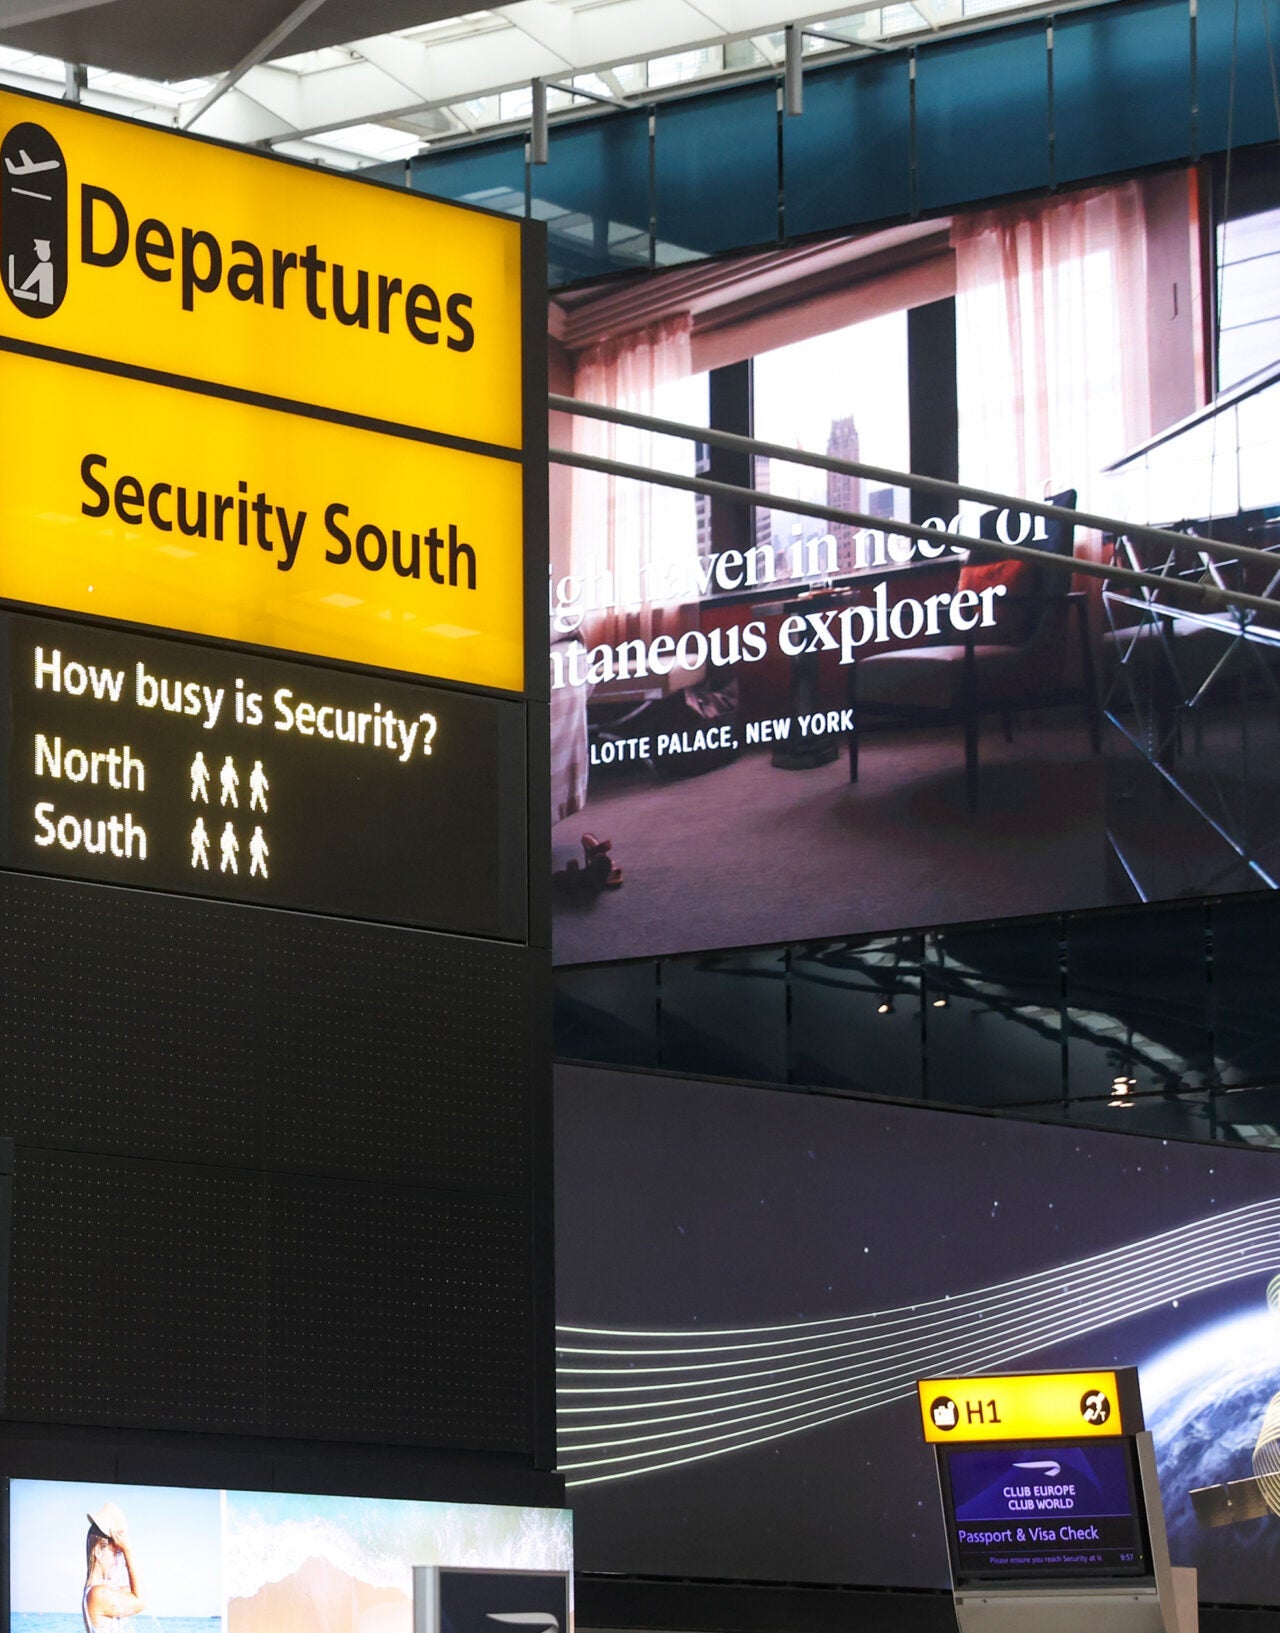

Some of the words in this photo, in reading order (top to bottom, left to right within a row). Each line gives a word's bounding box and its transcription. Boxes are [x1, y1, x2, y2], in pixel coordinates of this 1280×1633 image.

[79, 182, 476, 354] Departures
[79, 453, 308, 572] Security
[324, 502, 478, 591] South
[789, 522, 840, 578] in
[778, 581, 1007, 666] explorer
[33, 645, 125, 703] How
[135, 660, 225, 730] busy
[234, 677, 263, 726] is
[273, 687, 438, 763] Security?
[33, 733, 146, 792] North
[590, 736, 650, 765] LOTTE
[656, 725, 739, 756] PALACE,
[745, 717, 792, 745] NEW
[797, 708, 855, 737] YORK
[33, 801, 147, 861] South
[965, 1399, 1002, 1425] H1
[1003, 1486, 1032, 1498] CLUB
[1033, 1484, 1076, 1497] EUROPE
[1008, 1499, 1035, 1511] CLUB
[1036, 1498, 1074, 1510] WORLD
[958, 1529, 1013, 1546] Passport
[1016, 1527, 1027, 1542] &
[1028, 1526, 1057, 1542] Visa
[1059, 1524, 1100, 1541] Check
